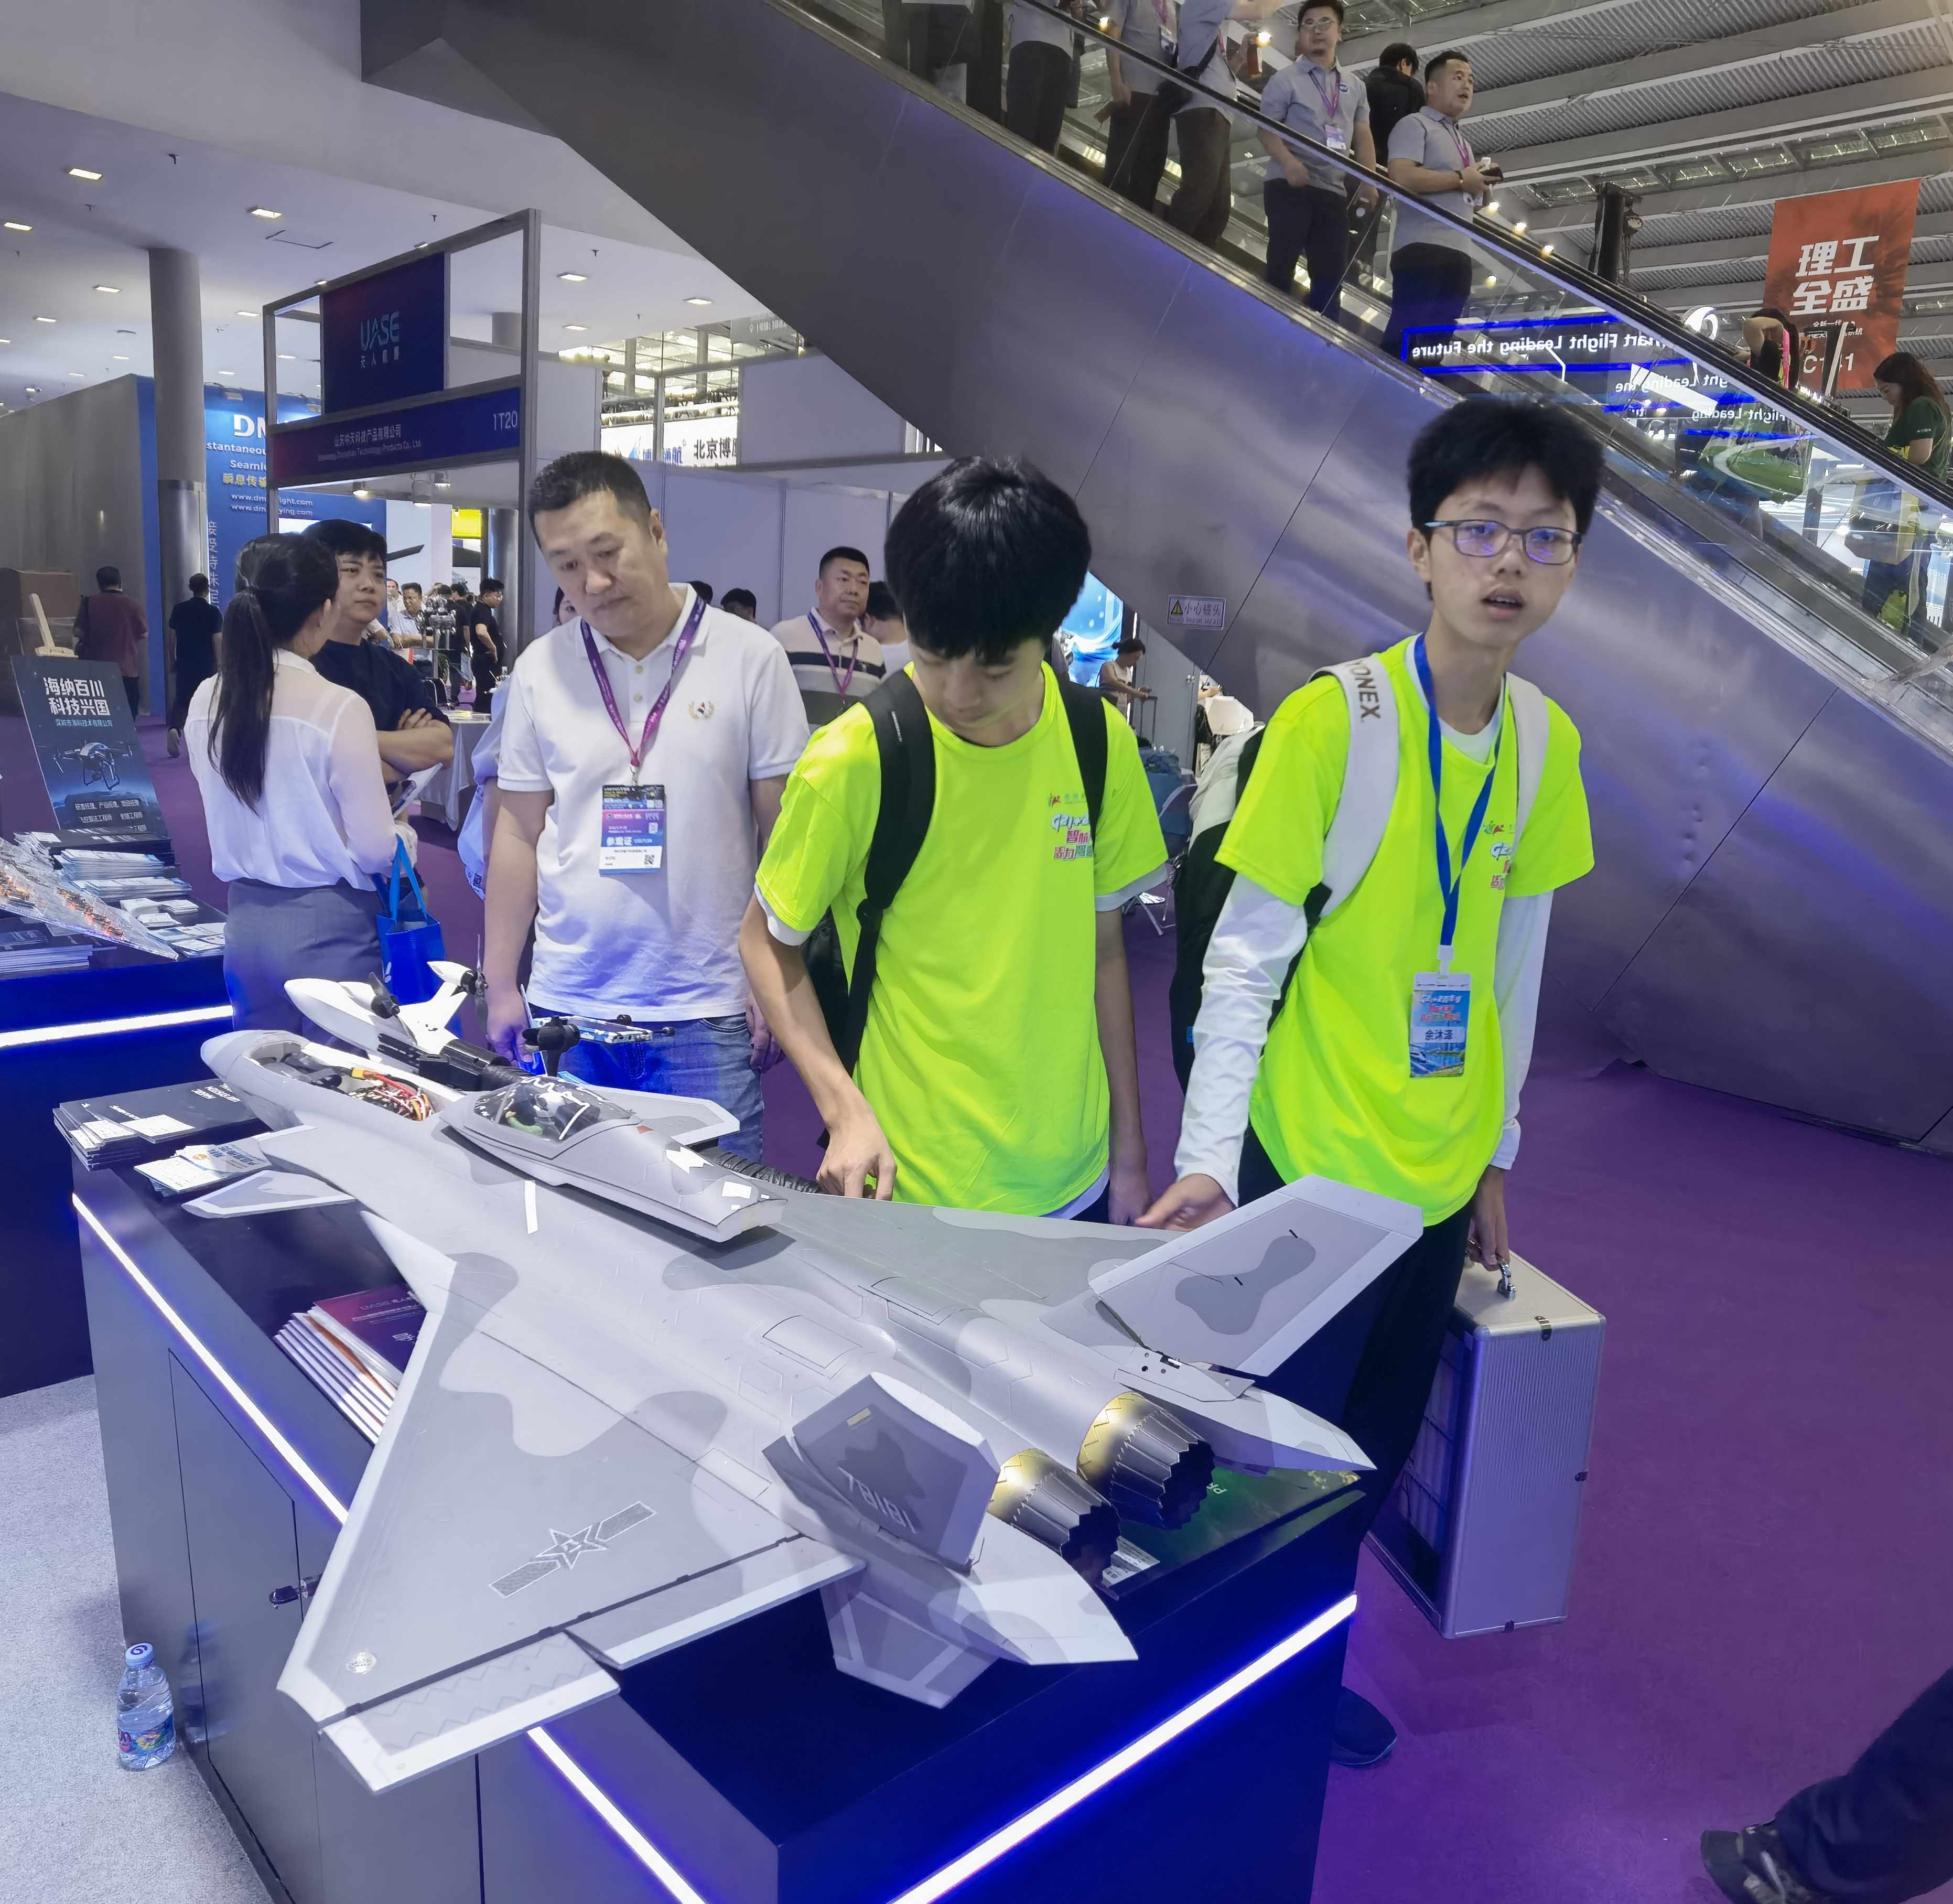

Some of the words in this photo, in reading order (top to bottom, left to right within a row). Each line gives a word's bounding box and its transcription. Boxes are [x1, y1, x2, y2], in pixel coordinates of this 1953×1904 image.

[1795, 235, 1879, 277] 理工
[1789, 275, 1874, 315] 全盛
[361, 310, 400, 351] UASE
[492, 411, 519, 432] 1T20
[694, 436, 738, 460] 北京博
[42, 677, 105, 697] 海纳百川
[48, 697, 111, 716] 科技兴国
